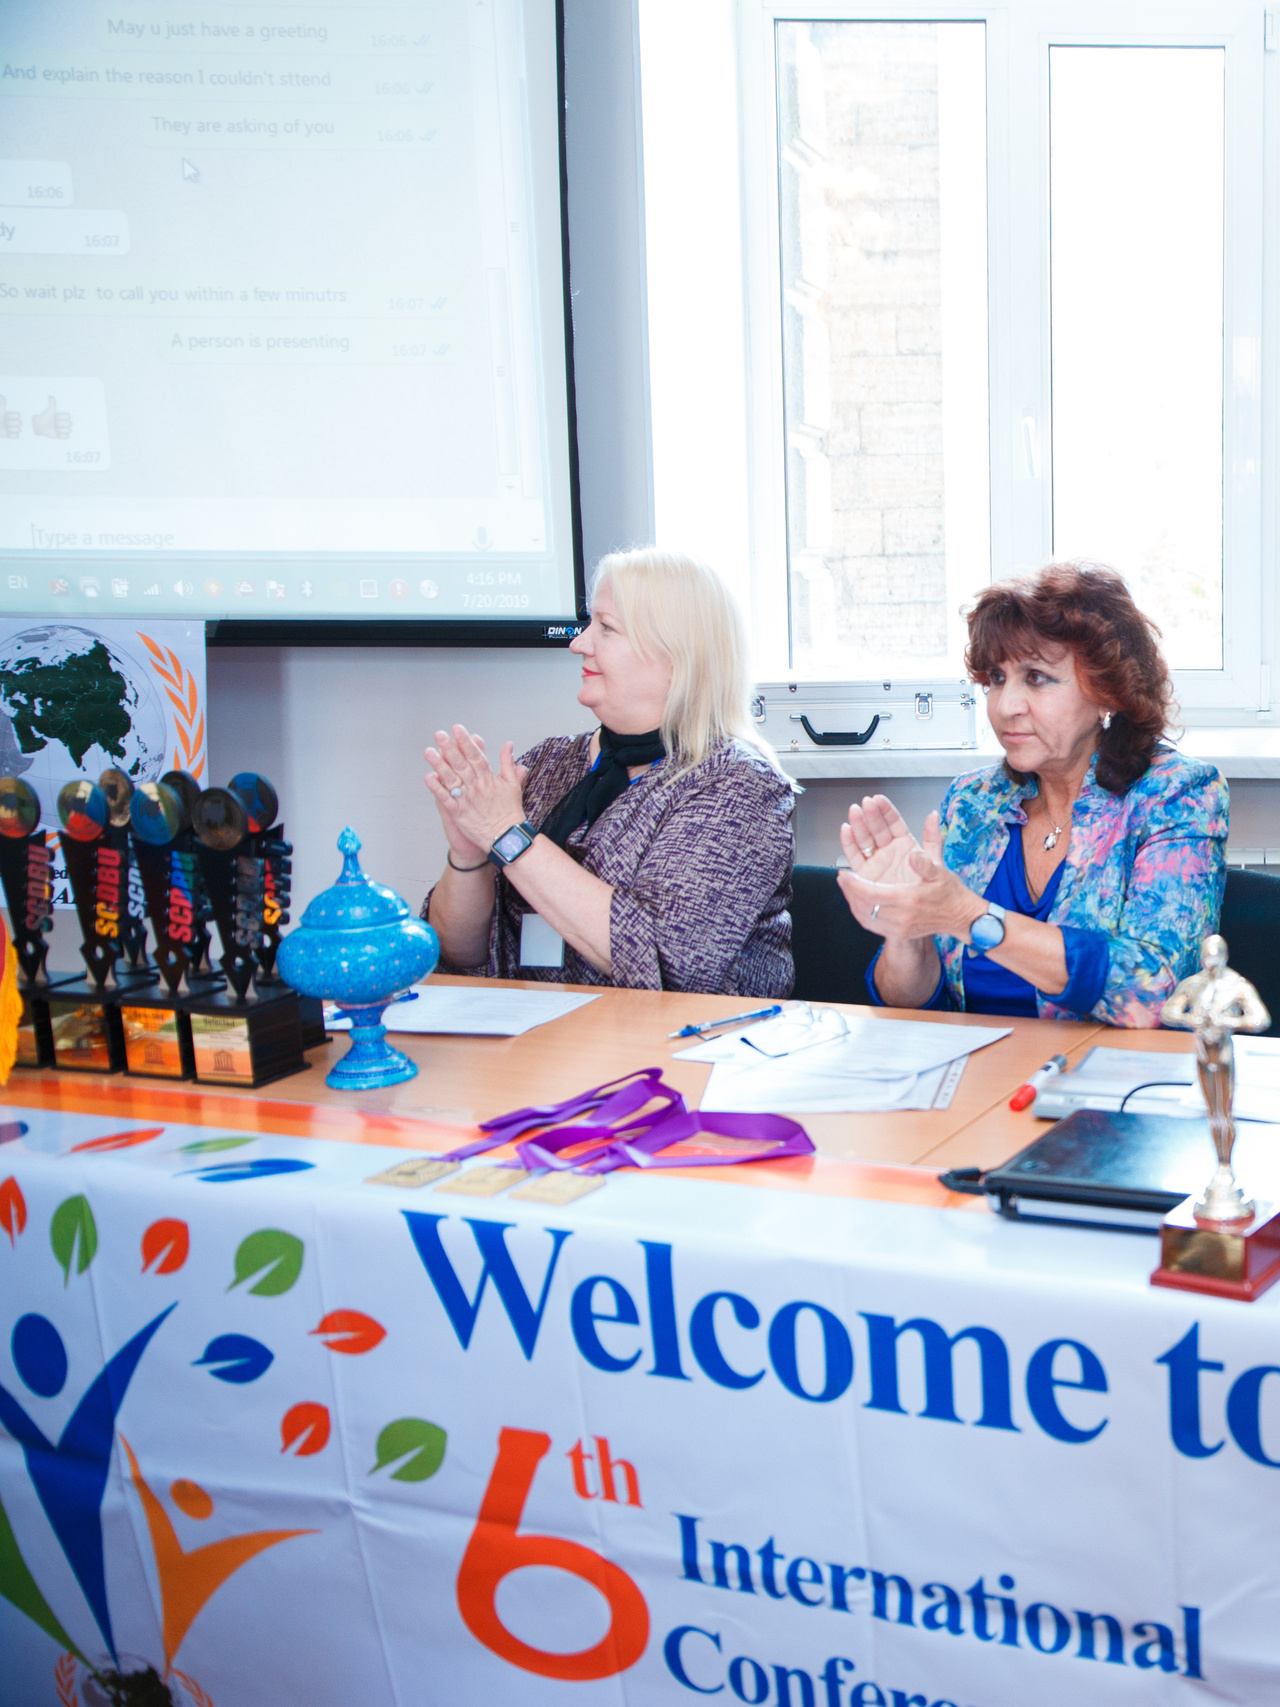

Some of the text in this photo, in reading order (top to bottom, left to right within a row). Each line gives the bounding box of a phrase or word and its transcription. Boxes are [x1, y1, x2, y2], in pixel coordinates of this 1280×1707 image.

[107, 18, 329, 43] May u just have a greeting
[1, 63, 332, 87] And explain the reason I couldn't sttend
[151, 116, 335, 138] They are asking of you
[27, 185, 64, 199] 16:06
[84, 234, 120, 248] 16:07
[23, 283, 58, 300] wait
[62, 284, 86, 303] plz
[96, 286, 114, 301] to
[118, 285, 144, 301] call
[149, 288, 180, 305] you
[184, 285, 235, 302] within
[239, 290, 249, 302] a
[253, 286, 281, 302] few
[285, 286, 347, 303] minutrs
[171, 333, 351, 353] A person is presenting
[65, 450, 102, 464] 16:07
[36, 528, 176, 549] Type a message
[8, 574, 29, 589] EN
[466, 571, 523, 587] 4:16 PM
[462, 593, 530, 609] 7/20/2019
[400, 1208, 1110, 1445] Welcome
[670, 1511, 1208, 1682] International
